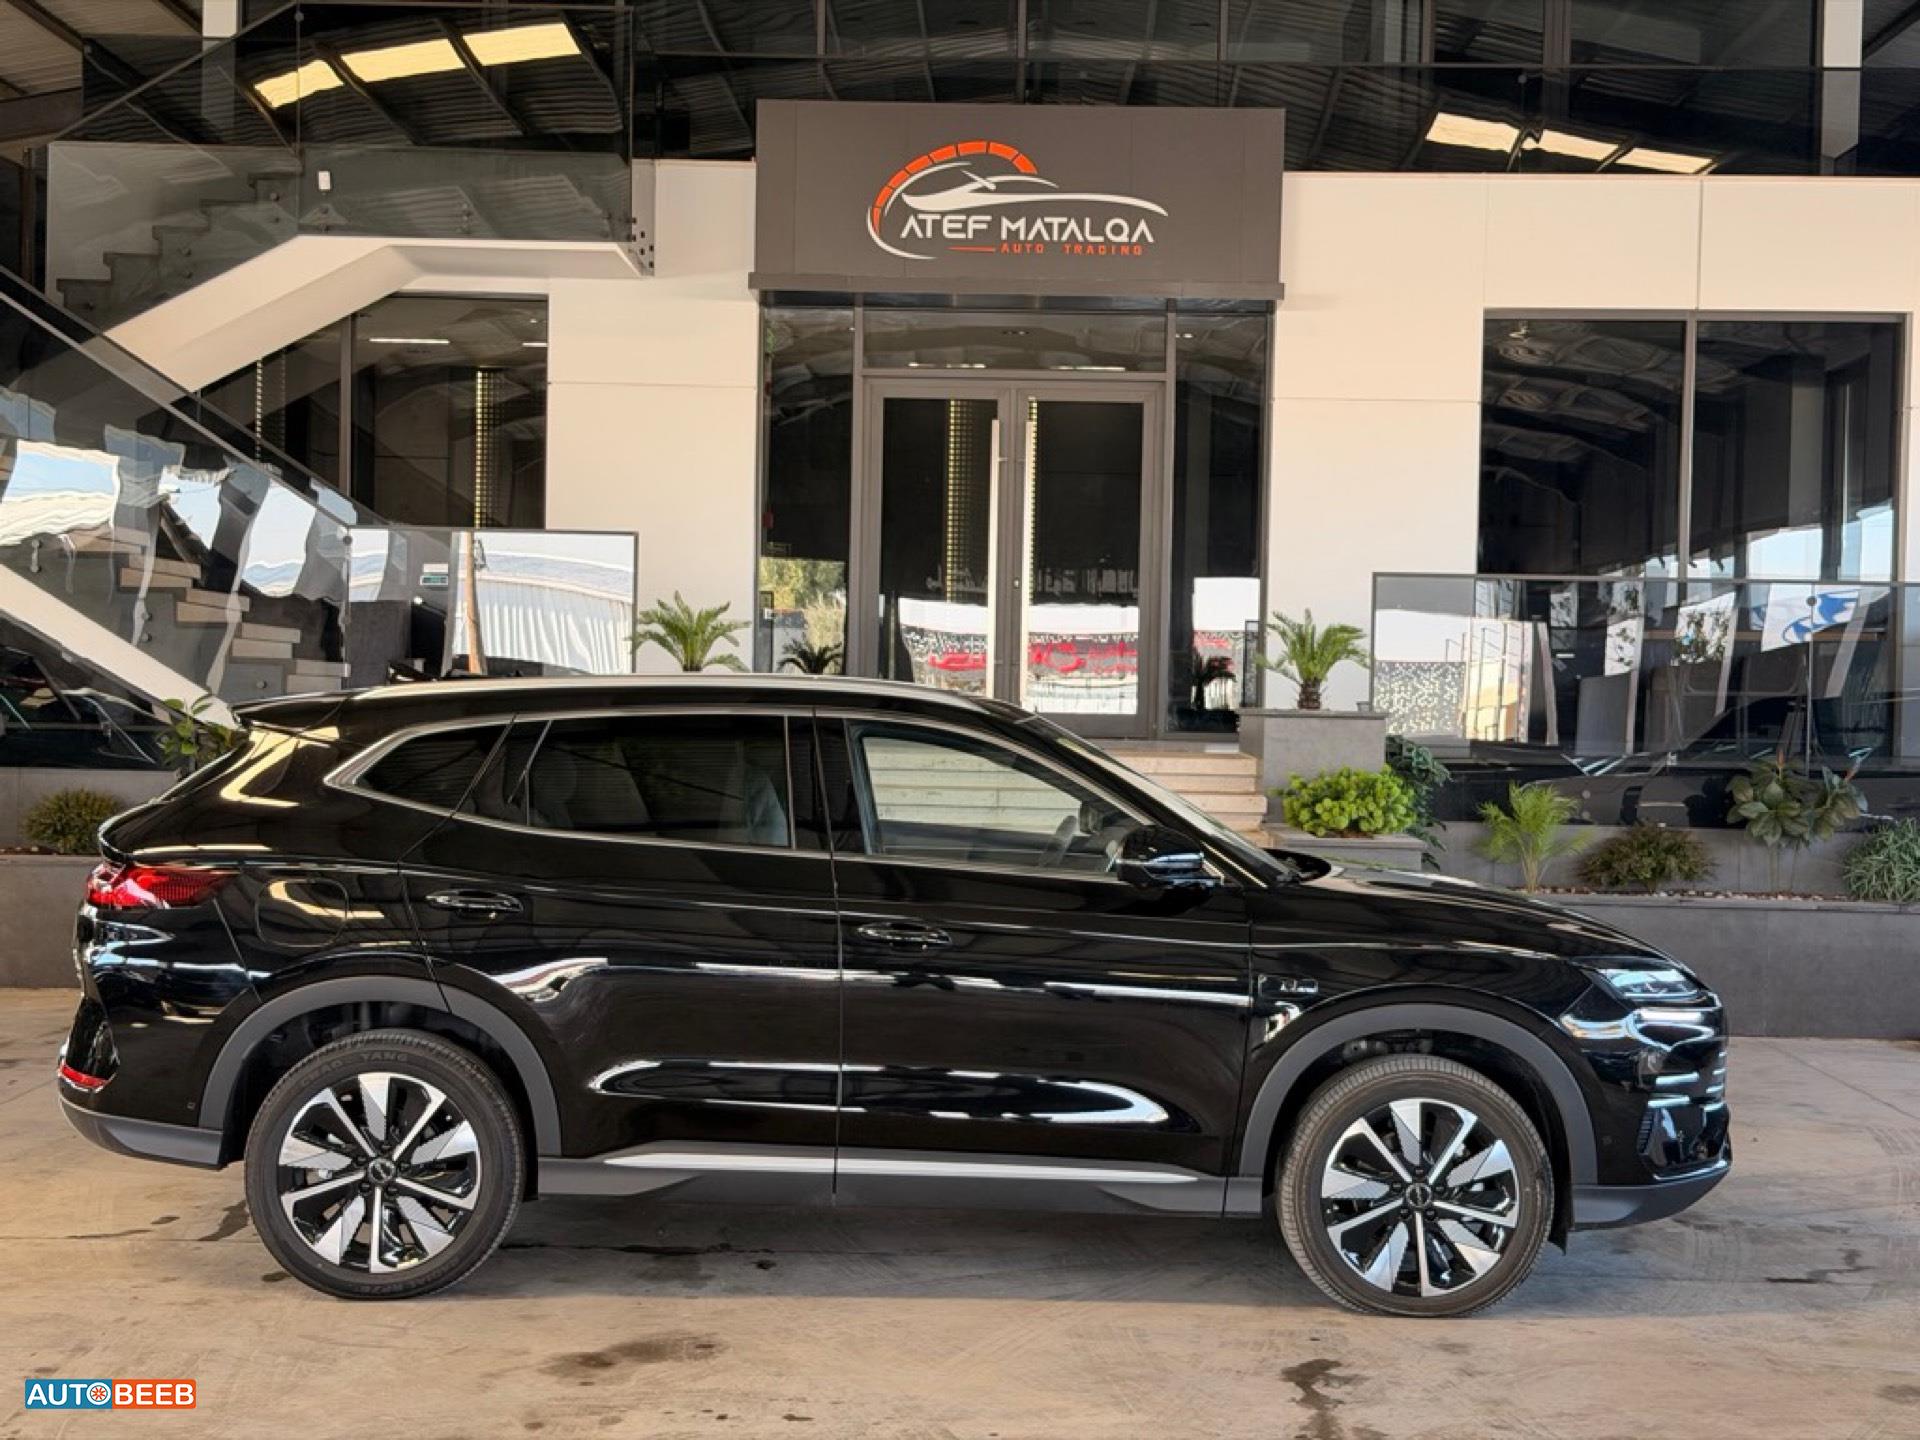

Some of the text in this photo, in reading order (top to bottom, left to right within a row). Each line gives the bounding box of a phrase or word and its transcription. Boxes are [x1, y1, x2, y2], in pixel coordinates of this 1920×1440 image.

[900, 213, 1155, 243] ATEF MATALQA
[1000, 243, 1144, 256] AUTO TRADING
